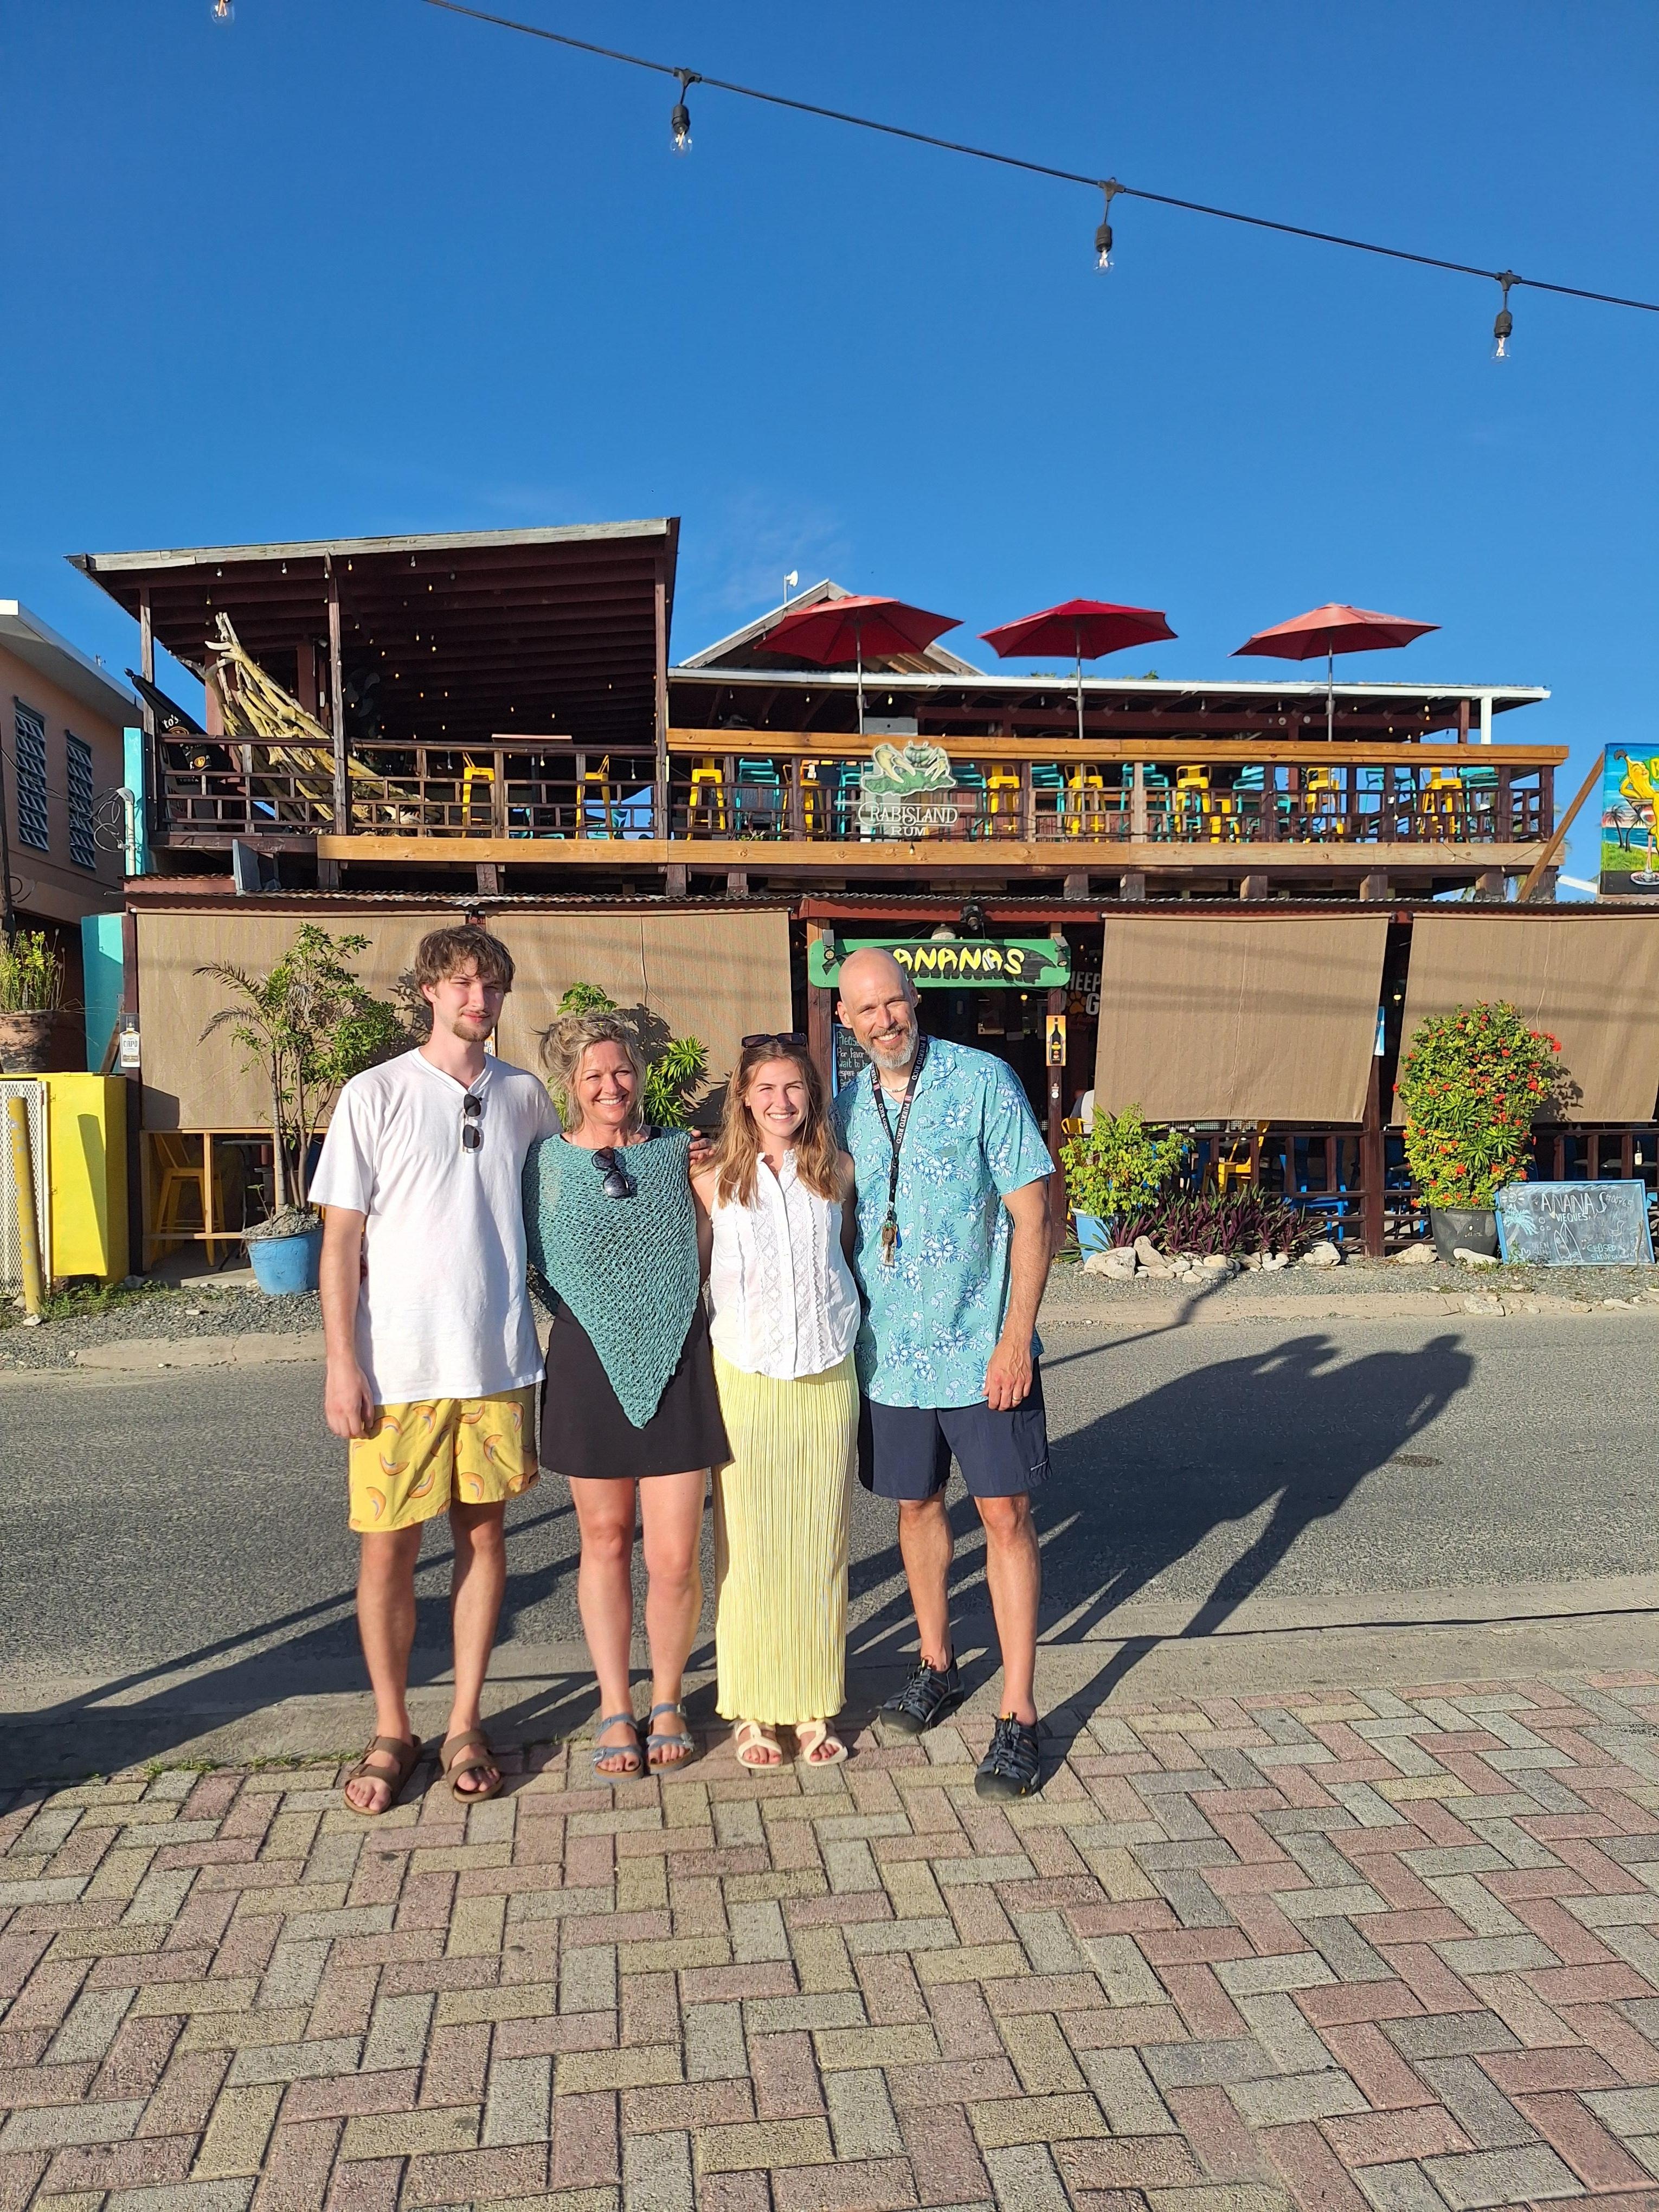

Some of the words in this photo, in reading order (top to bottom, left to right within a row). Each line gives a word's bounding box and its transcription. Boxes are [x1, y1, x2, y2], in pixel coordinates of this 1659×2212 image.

[162, 714, 179, 729] to's
[890, 826, 927, 837] RUM
[893, 947, 1025, 975] ANANAS
[1065, 970, 1101, 992] HEEP
[837, 1047, 847, 1057] Por
[850, 1047, 865, 1059] favor
[917, 1043, 926, 1066] PUERTO
[854, 1058, 860, 1068] to
[838, 1070, 855, 1080] espere
[911, 1065, 920, 1080] RICO
[899, 1103, 910, 1128] PUERTO
[896, 1127, 904, 1144] RICO
[1555, 1212, 1589, 1223] VIEQUES
